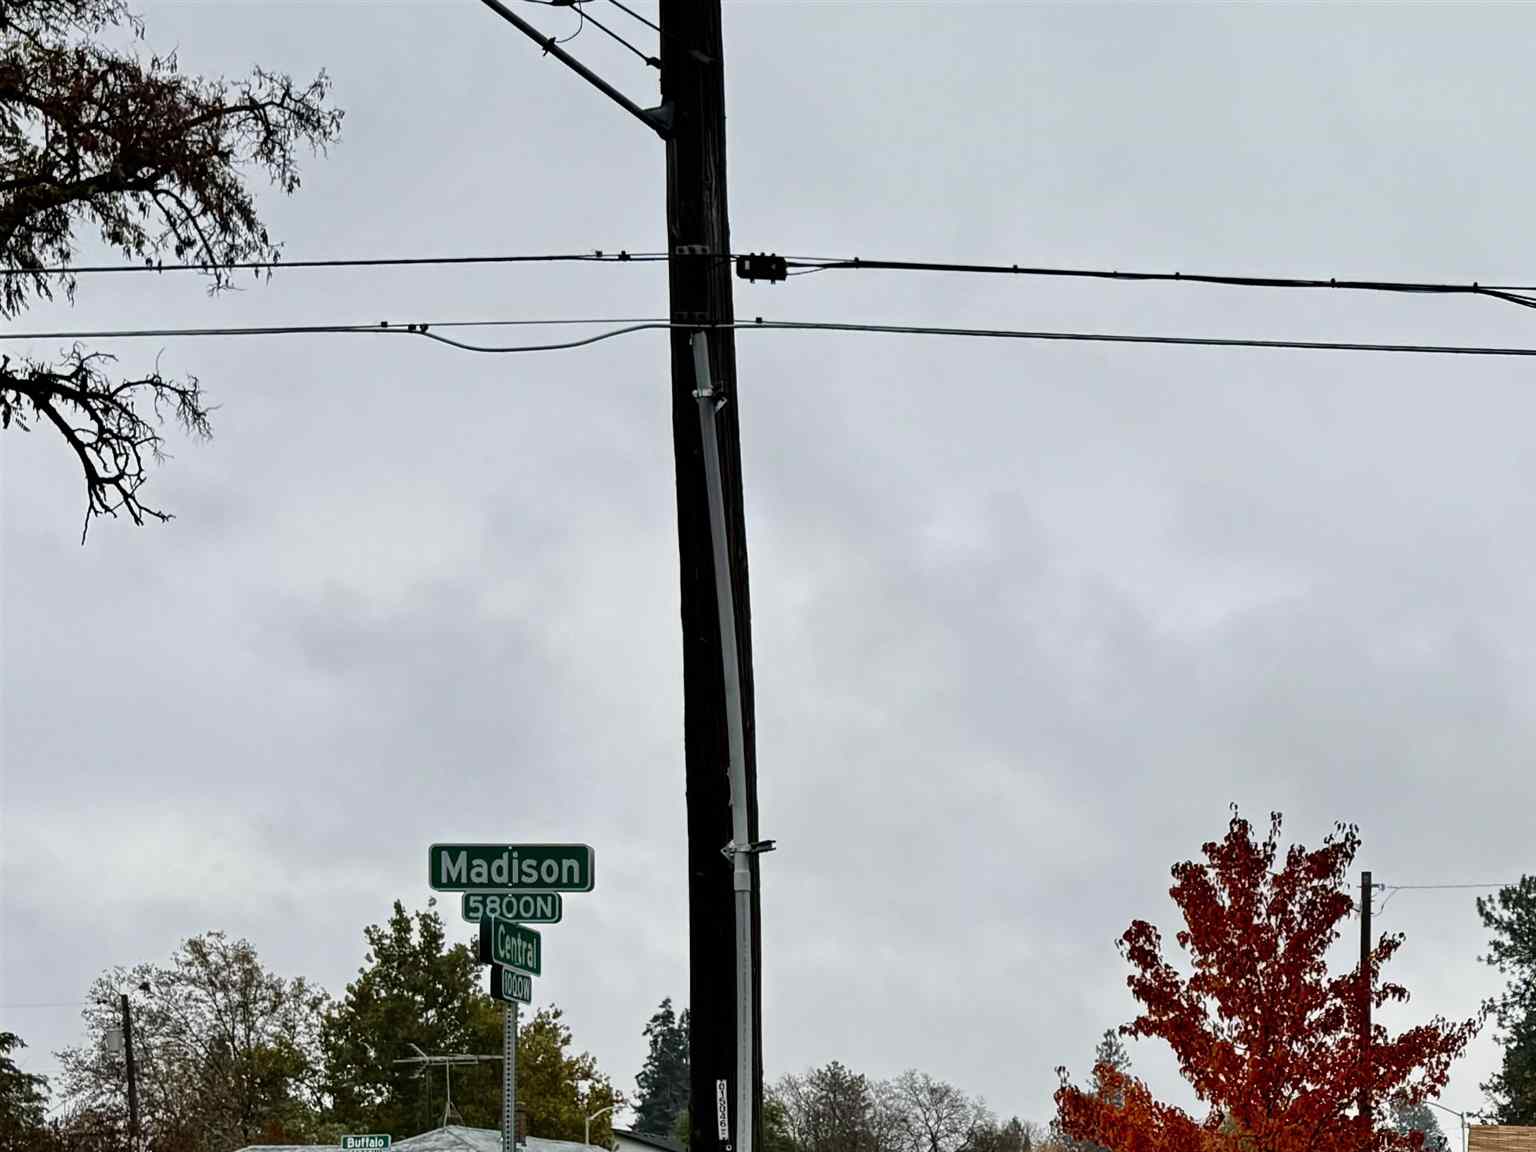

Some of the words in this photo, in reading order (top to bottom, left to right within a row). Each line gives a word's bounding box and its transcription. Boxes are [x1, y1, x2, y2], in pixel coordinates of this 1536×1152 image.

[440, 850, 580, 884] Madison
[468, 895, 553, 918] 5800N
[497, 923, 538, 970] Central
[347, 1137, 384, 1148] Buffalo
